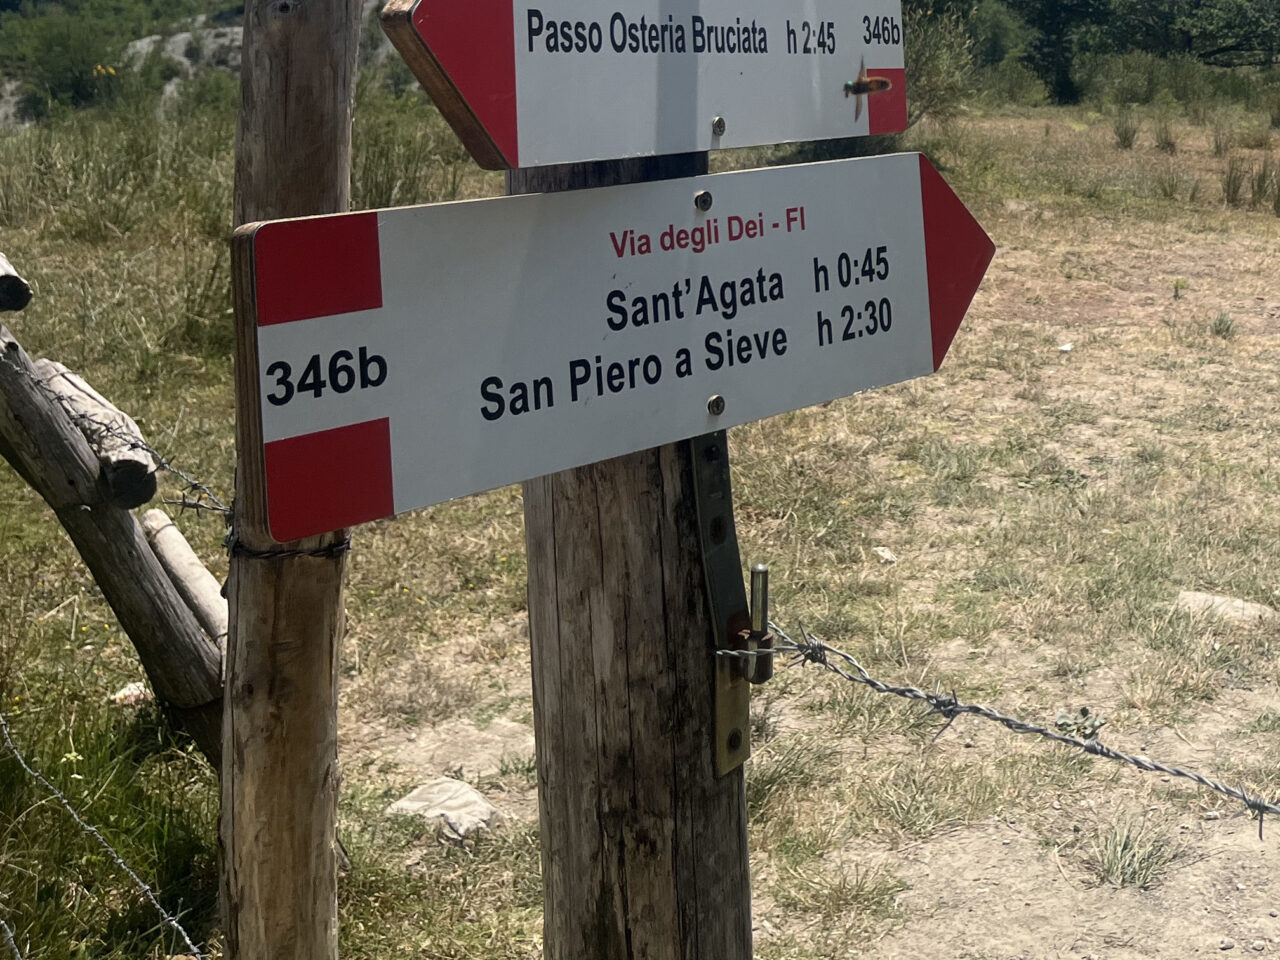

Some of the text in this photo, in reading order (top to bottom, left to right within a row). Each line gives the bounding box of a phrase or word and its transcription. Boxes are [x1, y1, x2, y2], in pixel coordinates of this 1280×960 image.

[526, 8, 603, 54] Passo
[609, 11, 687, 54] Osteria
[691, 15, 769, 54] Bruciata
[862, 15, 900, 46] 346b
[610, 231, 652, 258] Via
[659, 219, 720, 254] degli
[727, 213, 765, 242] Dei
[786, 206, 807, 233] FI
[837, 245, 890, 289] 0:45
[264, 345, 388, 408] 346b
[479, 375, 555, 422] San
[568, 353, 663, 403] Piero
[674, 347, 693, 379] a
[704, 327, 788, 372] Sieve
[840, 296, 893, 342] 2:30
